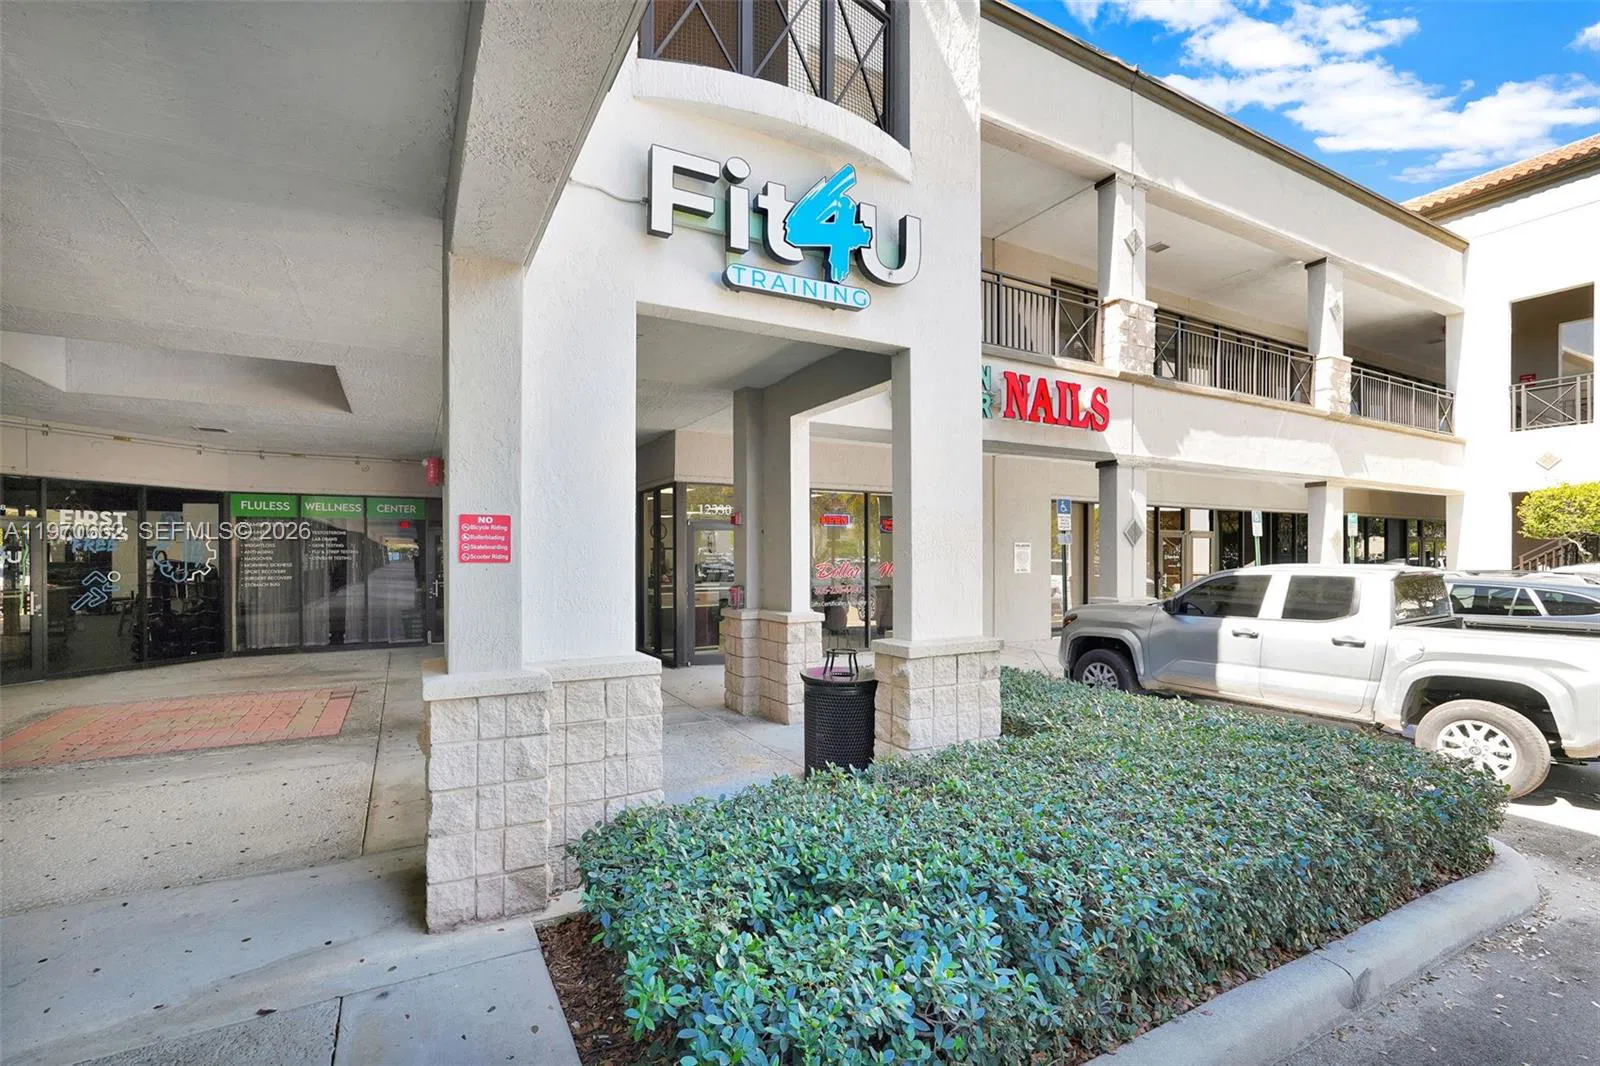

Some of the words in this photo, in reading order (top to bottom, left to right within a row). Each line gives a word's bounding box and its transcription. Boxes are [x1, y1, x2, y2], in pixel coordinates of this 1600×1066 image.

[732, 266, 868, 307] TRAINING
[1003, 371, 1110, 432] NAILS
[240, 500, 290, 511] FLULESS
[305, 502, 361, 512] WELLNESS
[376, 504, 417, 514] CENTER
[59, 509, 128, 526] FIRST
[477, 516, 494, 524] NO
